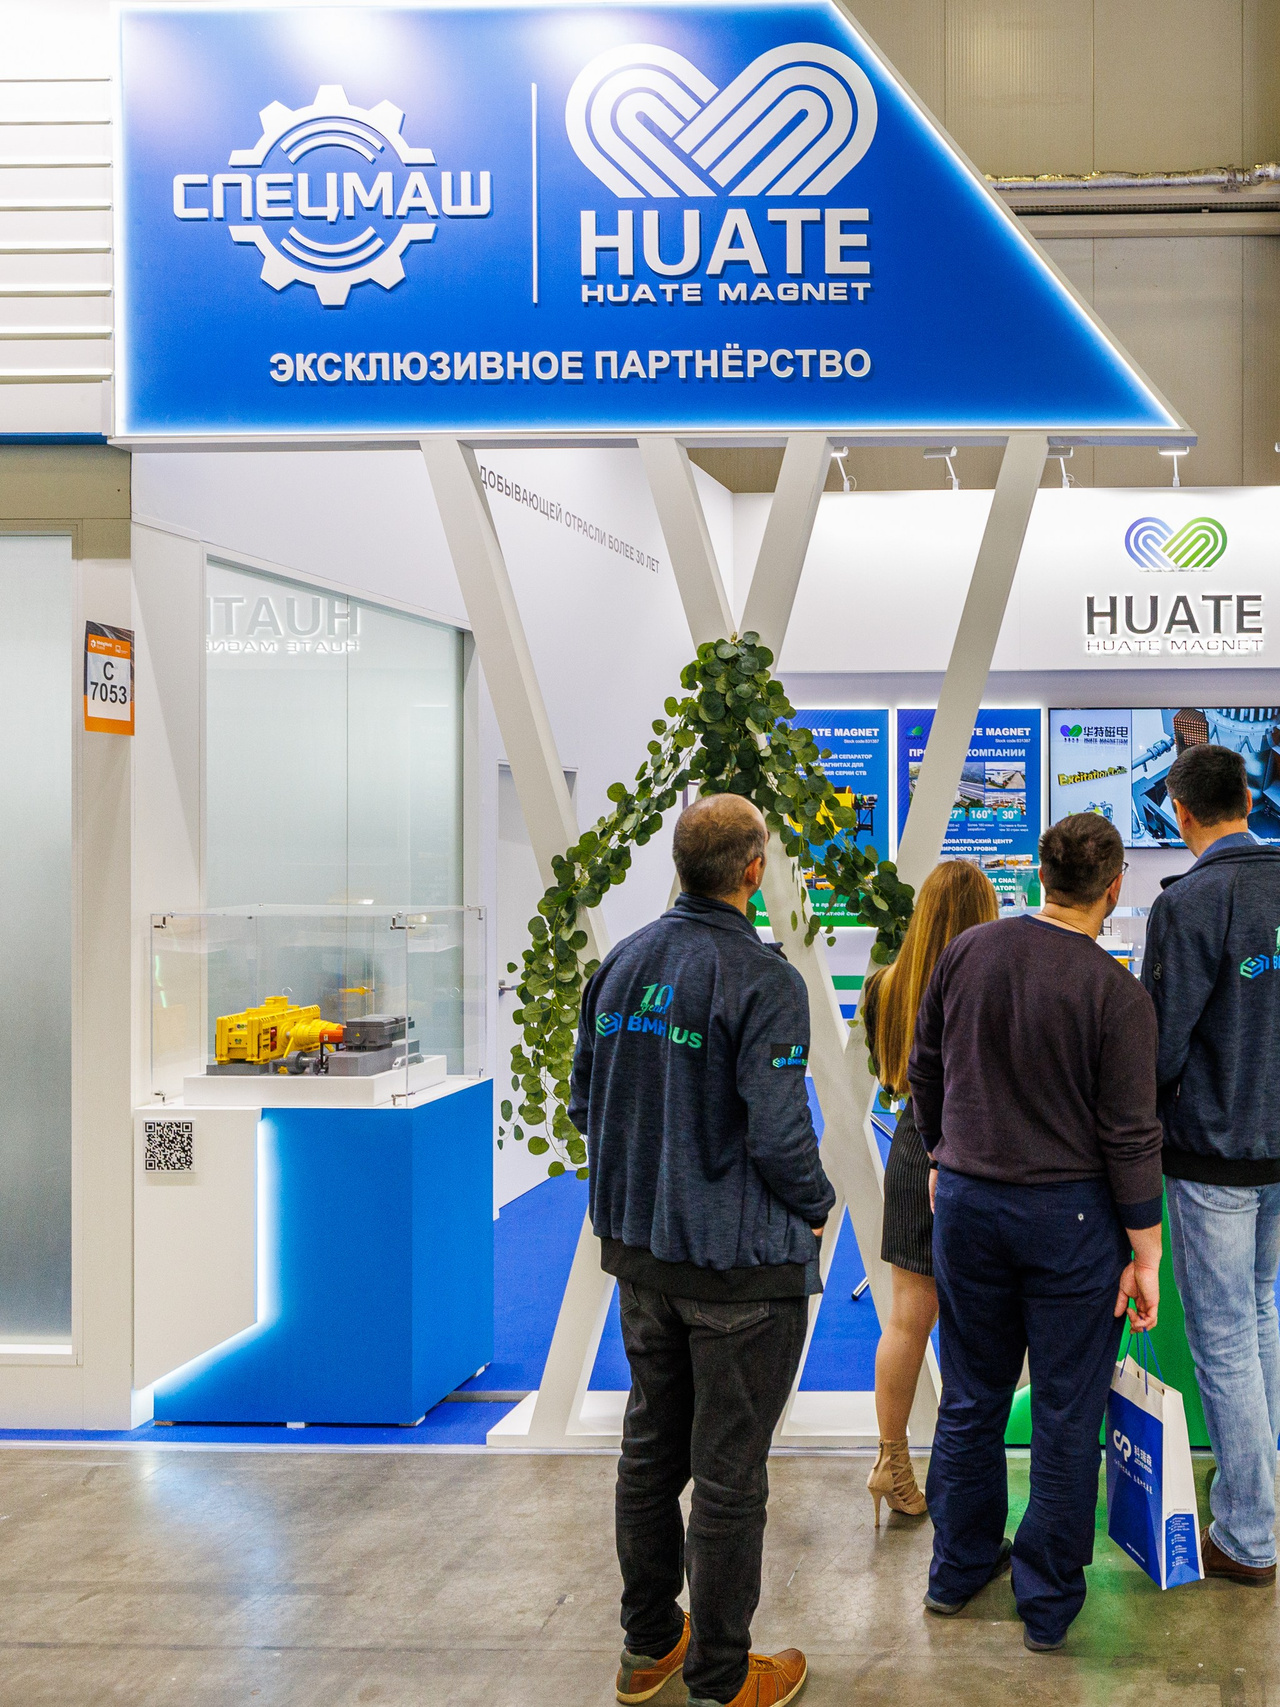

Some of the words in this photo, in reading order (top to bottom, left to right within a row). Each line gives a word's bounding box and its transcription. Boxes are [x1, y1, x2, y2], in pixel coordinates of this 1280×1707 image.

[172, 170, 491, 223] СПЕЦМАШ
[580, 208, 871, 277] HUATE
[581, 283, 702, 303] HUATE
[718, 282, 871, 302] MAGNET
[269, 351, 584, 383] ЭКСКЛЮЗИВНОЕ
[595, 343, 872, 380] ПАРТНЁРСТВО
[565, 511, 607, 547] ОТРАСЛИ
[608, 534, 635, 561] БОЛЕЕ
[635, 549, 645, 567] 30
[646, 555, 660, 574] ЛЕТ
[1086, 594, 1263, 635] HUATE
[1087, 640, 1160, 651] HUATE
[1170, 639, 1264, 651] MAGNET
[90, 681, 128, 705] 7053
[811, 728, 832, 737] ATE
[834, 728, 880, 737] MAGNET
[985, 727, 1031, 736] MAGNET
[1083, 726, 1129, 738] 华特磁电
[971, 809, 992, 819] 160+
[1002, 809, 1018, 819] 30+
[641, 982, 675, 1007] 10
[668, 1024, 703, 1049] US
